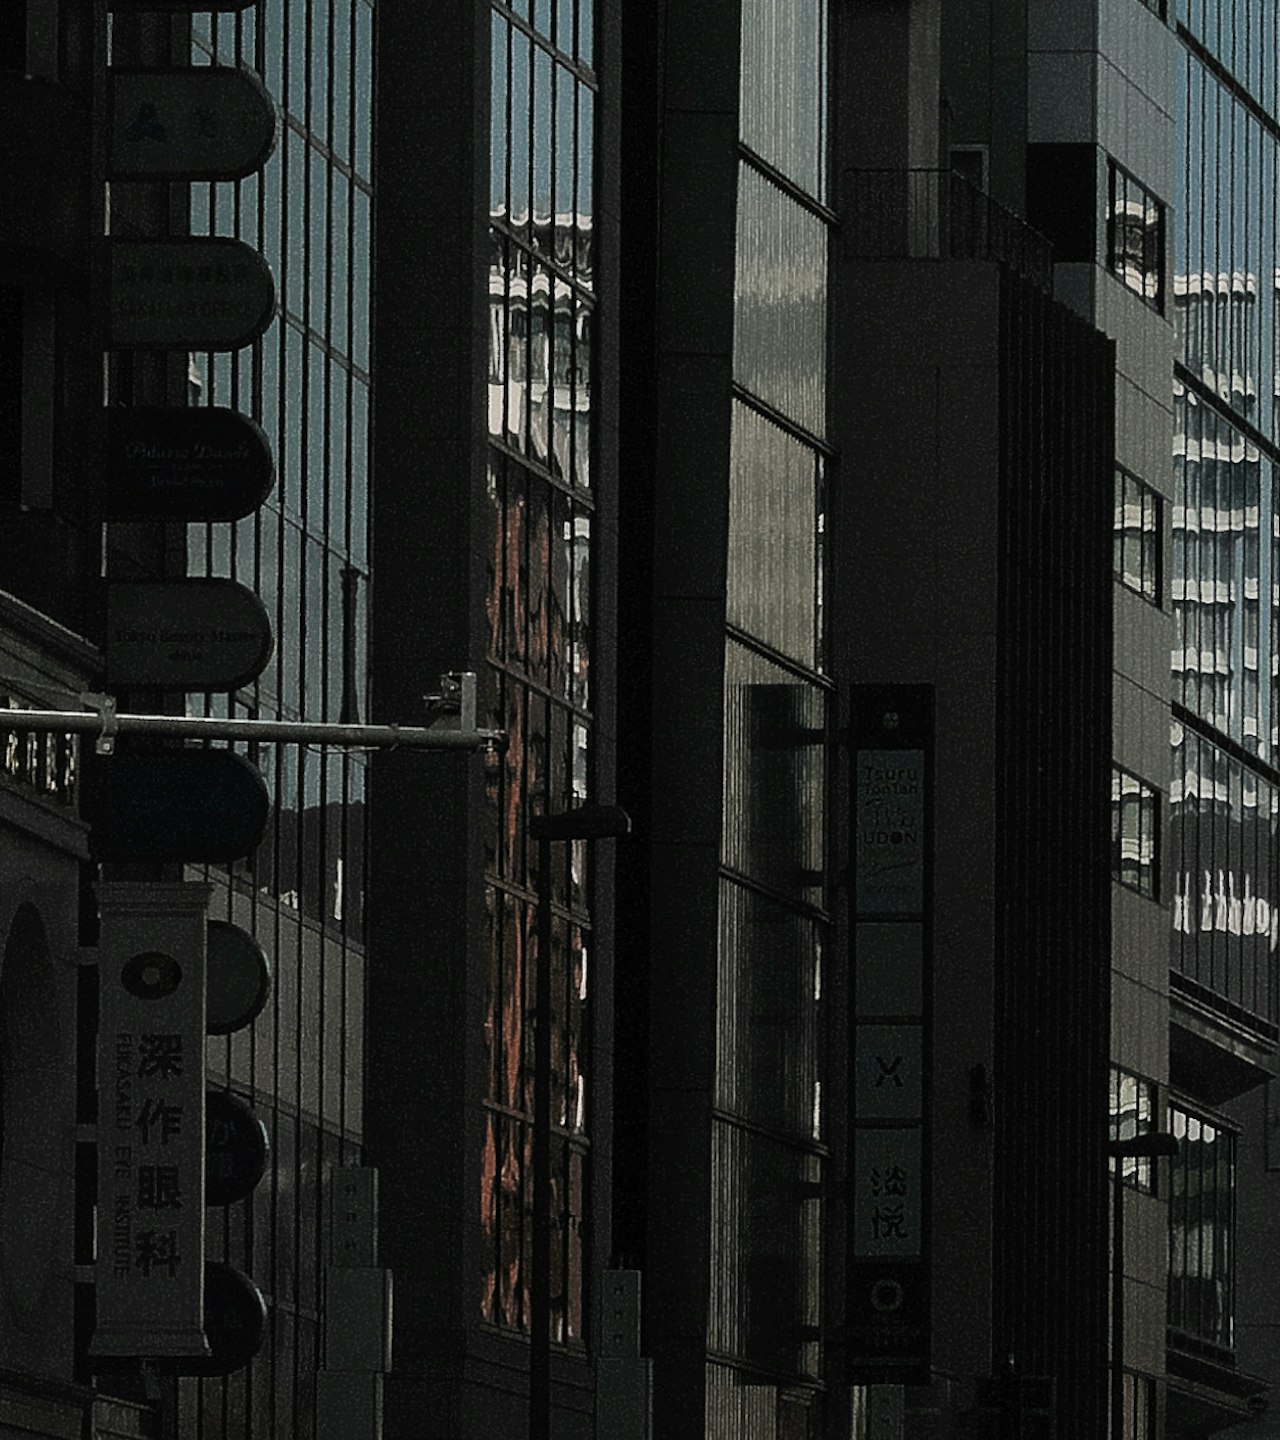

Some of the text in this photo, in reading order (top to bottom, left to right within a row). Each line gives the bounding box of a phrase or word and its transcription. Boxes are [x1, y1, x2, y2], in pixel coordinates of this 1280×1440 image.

[115, 1146, 132, 1179] EYE
[135, 1033, 183, 1277] 深作眼科
